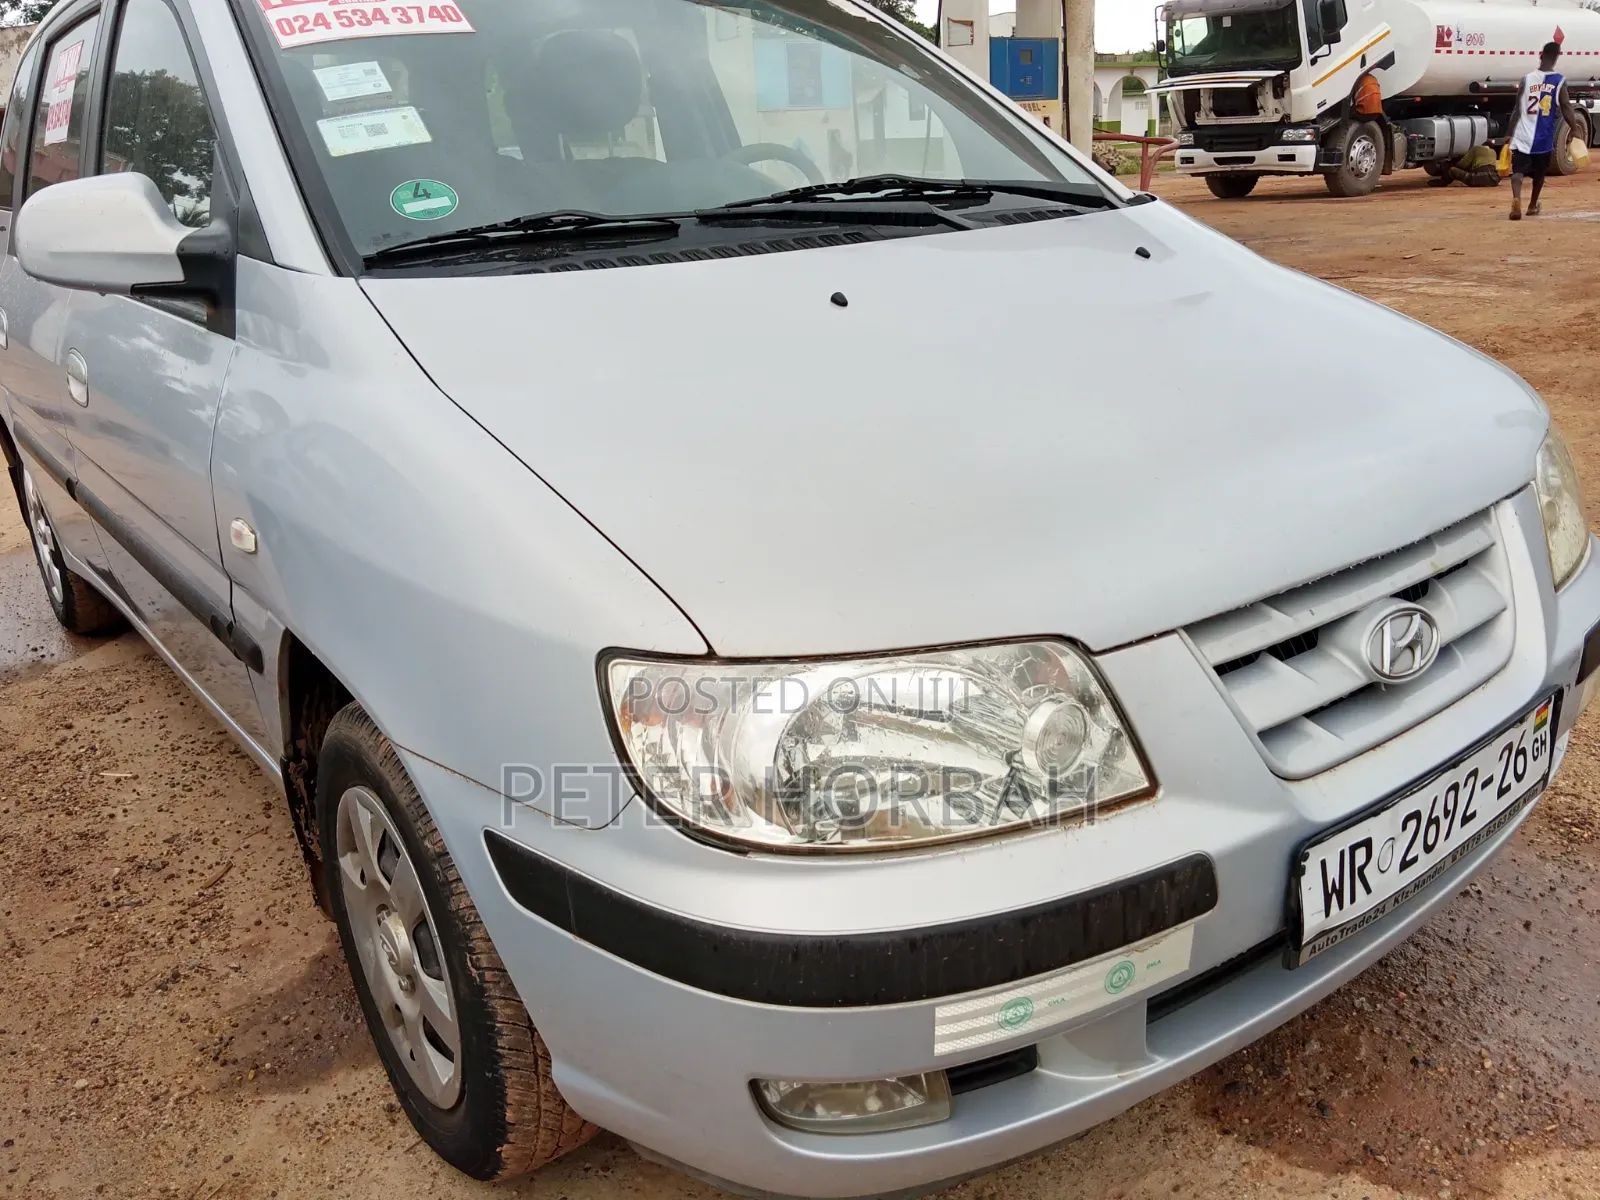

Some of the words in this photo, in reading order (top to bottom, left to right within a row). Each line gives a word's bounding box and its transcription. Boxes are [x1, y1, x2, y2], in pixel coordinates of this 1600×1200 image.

[275, 11, 332, 37] 024
[333, 7, 390, 29] 534
[391, 4, 464, 25] 3740
[1528, 95, 1552, 116] 24
[413, 182, 431, 200] 4
[1532, 731, 1547, 763] GH
[1320, 836, 1373, 919] WR
[1398, 729, 1528, 875] 2692-26
[1392, 860, 1446, 908] Kfz-Handel
